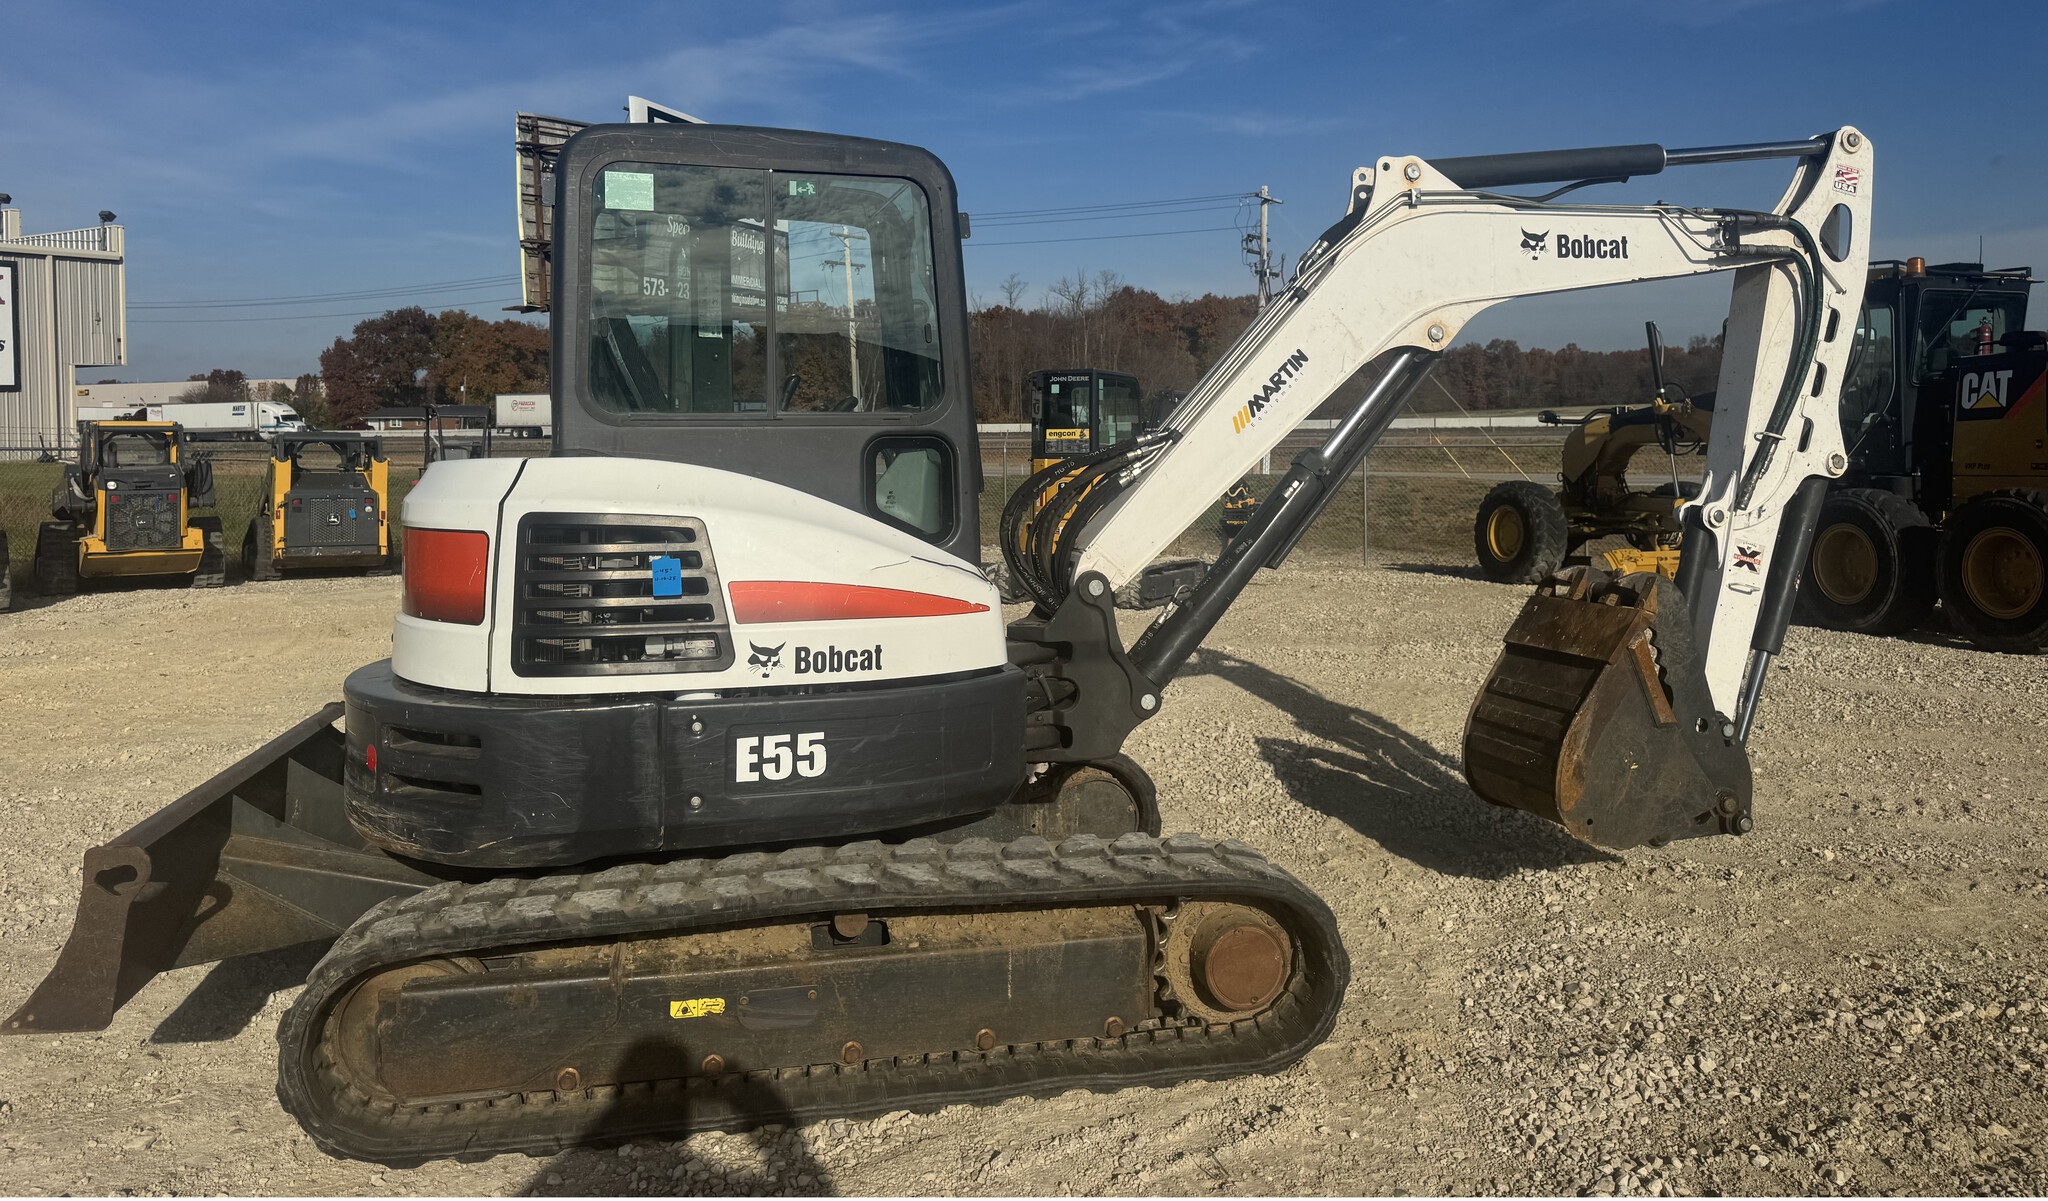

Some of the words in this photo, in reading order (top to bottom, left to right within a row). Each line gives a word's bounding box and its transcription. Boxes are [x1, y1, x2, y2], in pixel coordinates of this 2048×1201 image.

[1835, 181, 1855, 193] USA
[731, 230, 766, 255] Building
[1557, 234, 1629, 259] Bobcat
[1248, 349, 1309, 418] MARTIN
[1961, 369, 2013, 409] CAT
[1250, 371, 1304, 428] Equipment
[1048, 430, 1076, 438] engcon
[795, 644, 883, 674] Bobcat
[736, 731, 827, 783] E55
